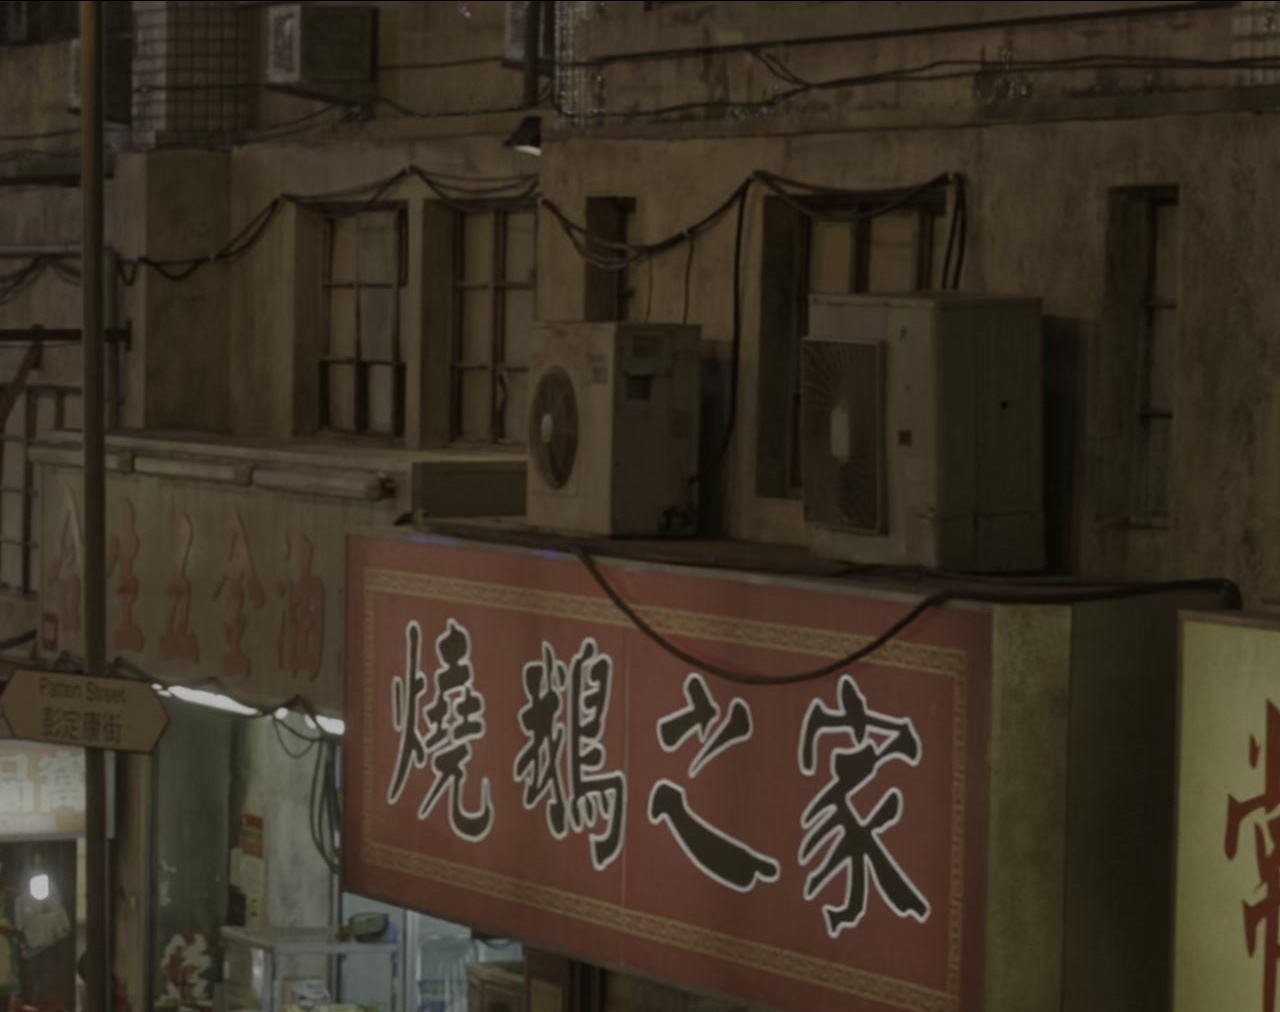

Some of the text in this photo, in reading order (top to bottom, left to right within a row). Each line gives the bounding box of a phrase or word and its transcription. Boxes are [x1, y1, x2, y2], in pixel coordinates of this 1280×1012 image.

[85, 681, 127, 704] Street
[386, 617, 932, 939] 燒鵝之家
